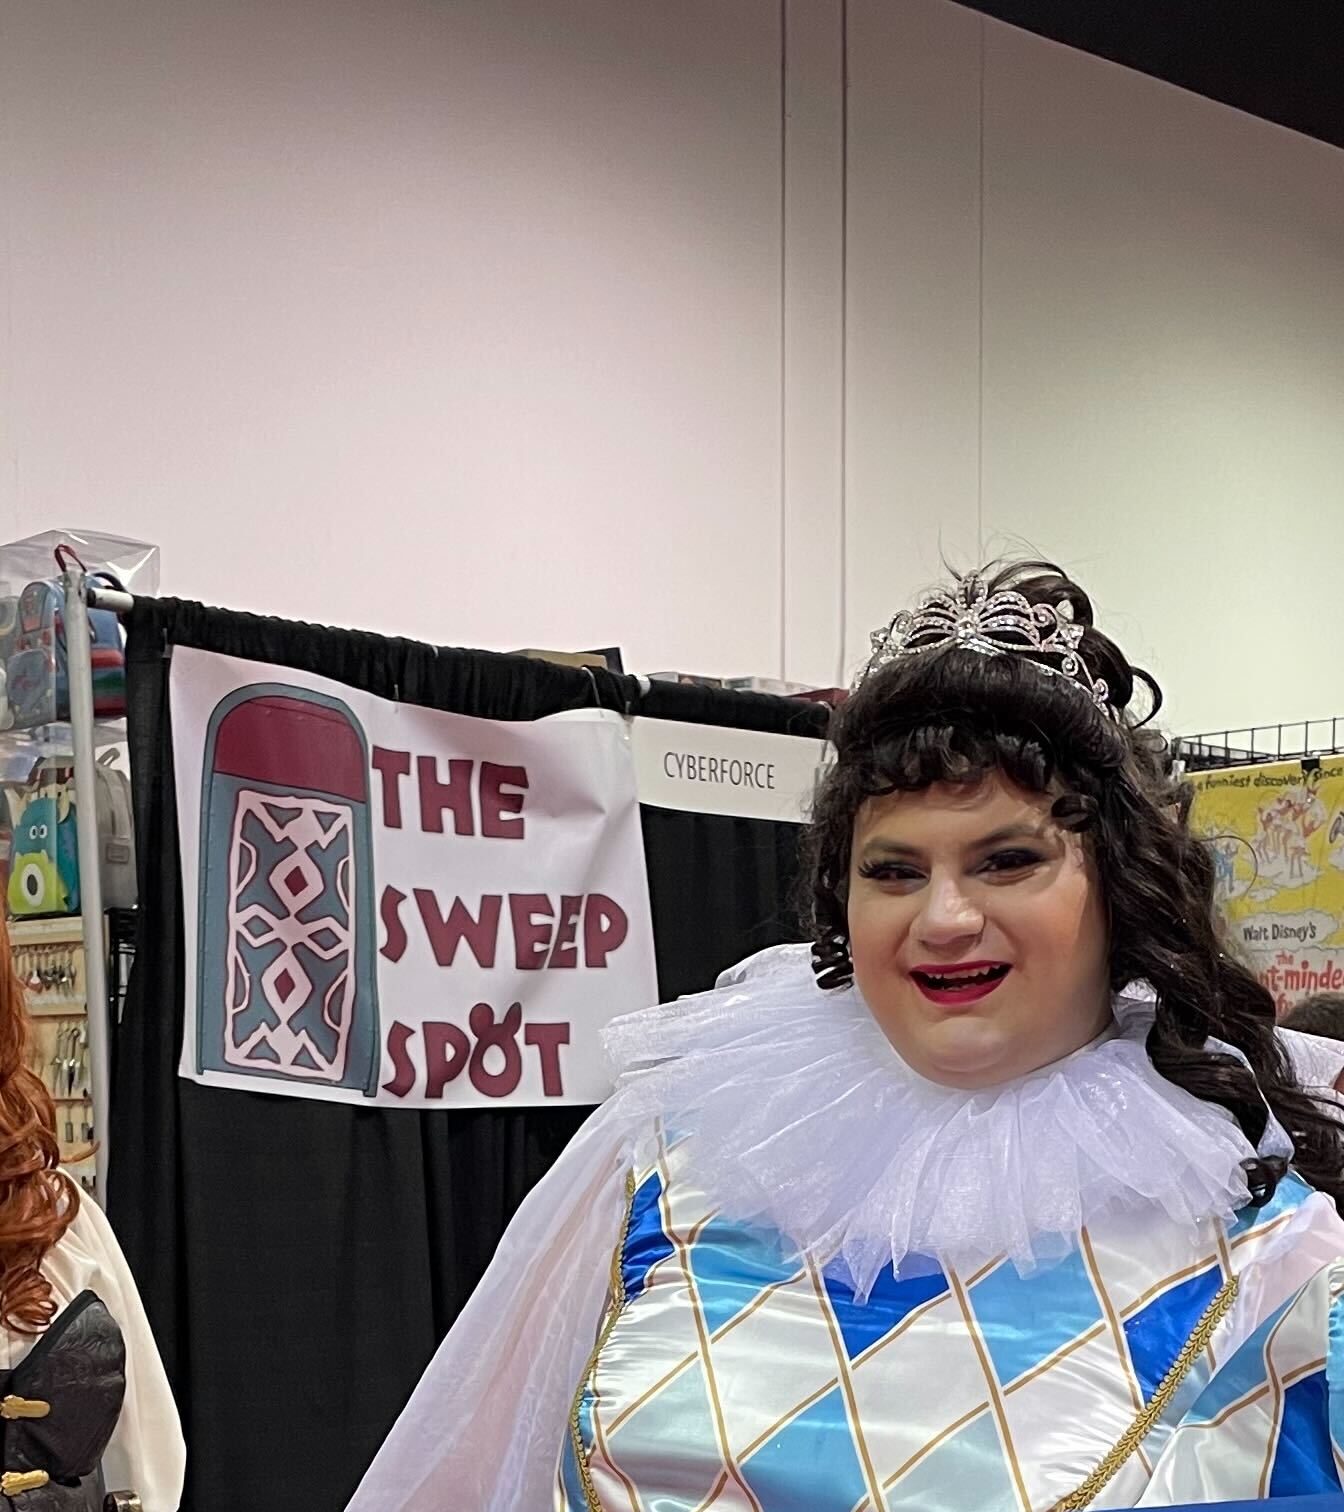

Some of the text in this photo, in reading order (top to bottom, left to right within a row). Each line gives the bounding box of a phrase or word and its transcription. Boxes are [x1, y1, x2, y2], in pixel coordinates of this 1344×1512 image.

[370, 745, 529, 840] THE
[663, 751, 776, 790] CYBERFORCE
[1205, 774, 1251, 790] funniest
[379, 884, 629, 971] SWEEP
[1243, 921, 1317, 942] Walt Disney's
[381, 1001, 571, 1099] SPOT
